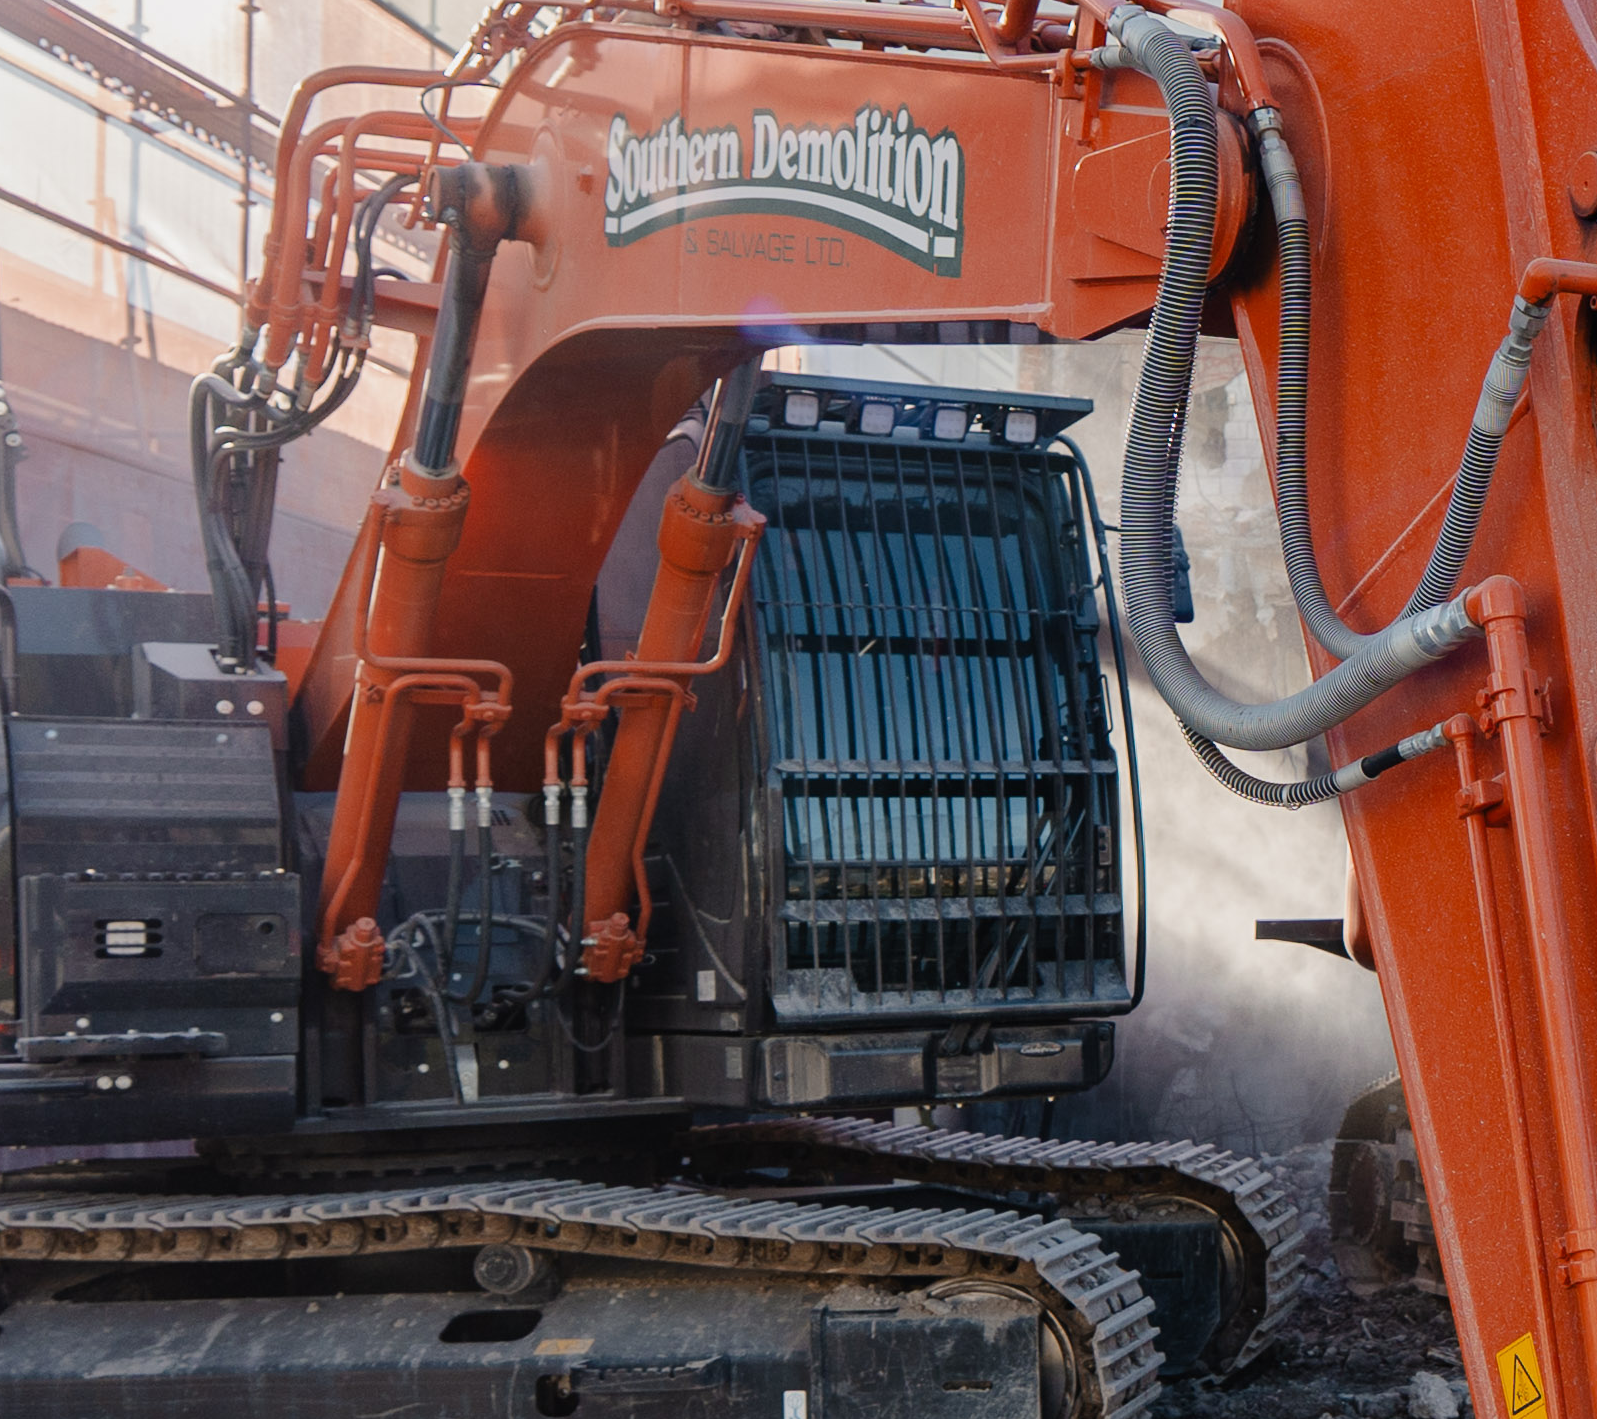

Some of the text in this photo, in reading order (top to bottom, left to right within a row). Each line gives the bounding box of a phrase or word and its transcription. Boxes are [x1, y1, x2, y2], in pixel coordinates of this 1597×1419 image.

[605, 106, 960, 231] Southern Demolition
[685, 228, 851, 268] & SALVAGE LTD.
